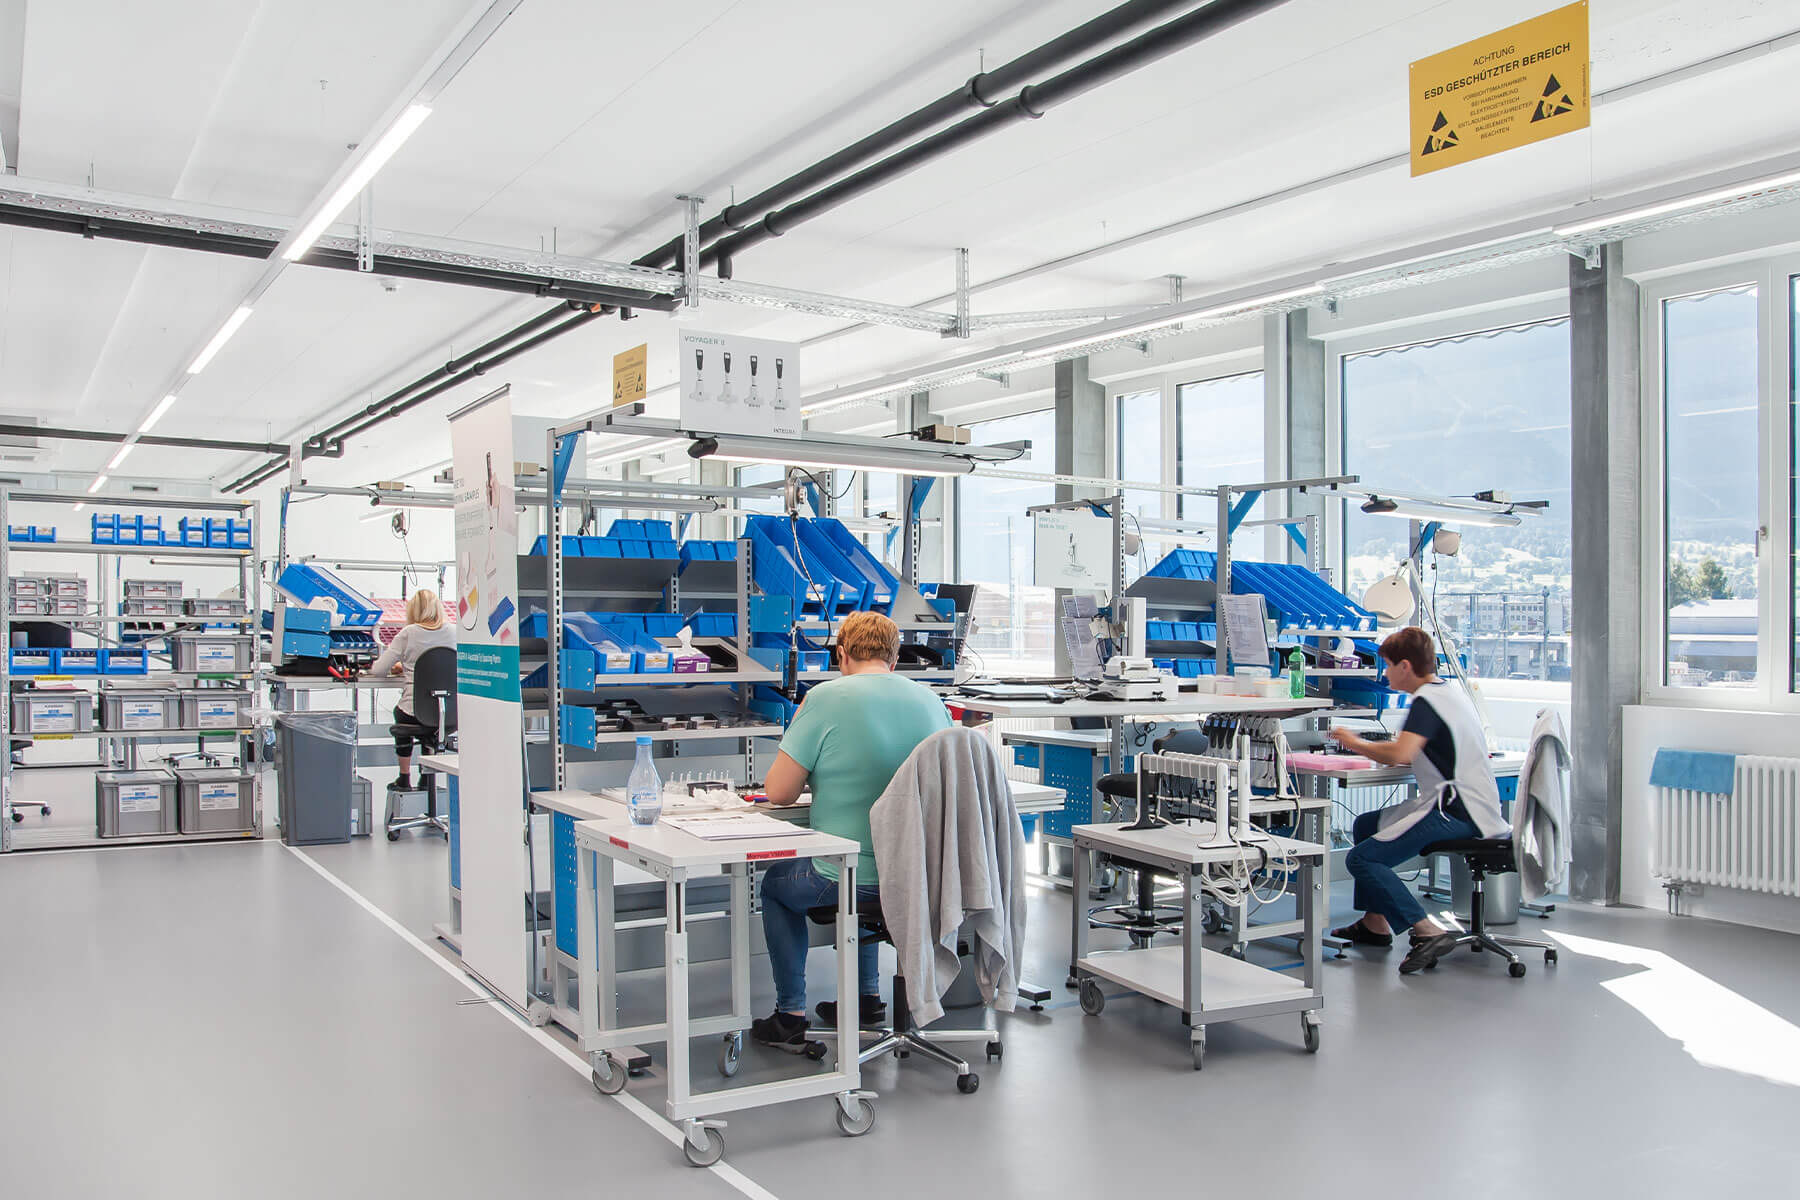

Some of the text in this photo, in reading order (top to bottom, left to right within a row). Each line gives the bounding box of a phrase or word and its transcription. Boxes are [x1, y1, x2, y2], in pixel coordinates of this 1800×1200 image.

[1473, 45, 1515, 66] ACHTUNG
[1424, 42, 1571, 100] ESD GESCHÜTZTER BEREICH
[684, 335, 718, 345] VOYAGER
